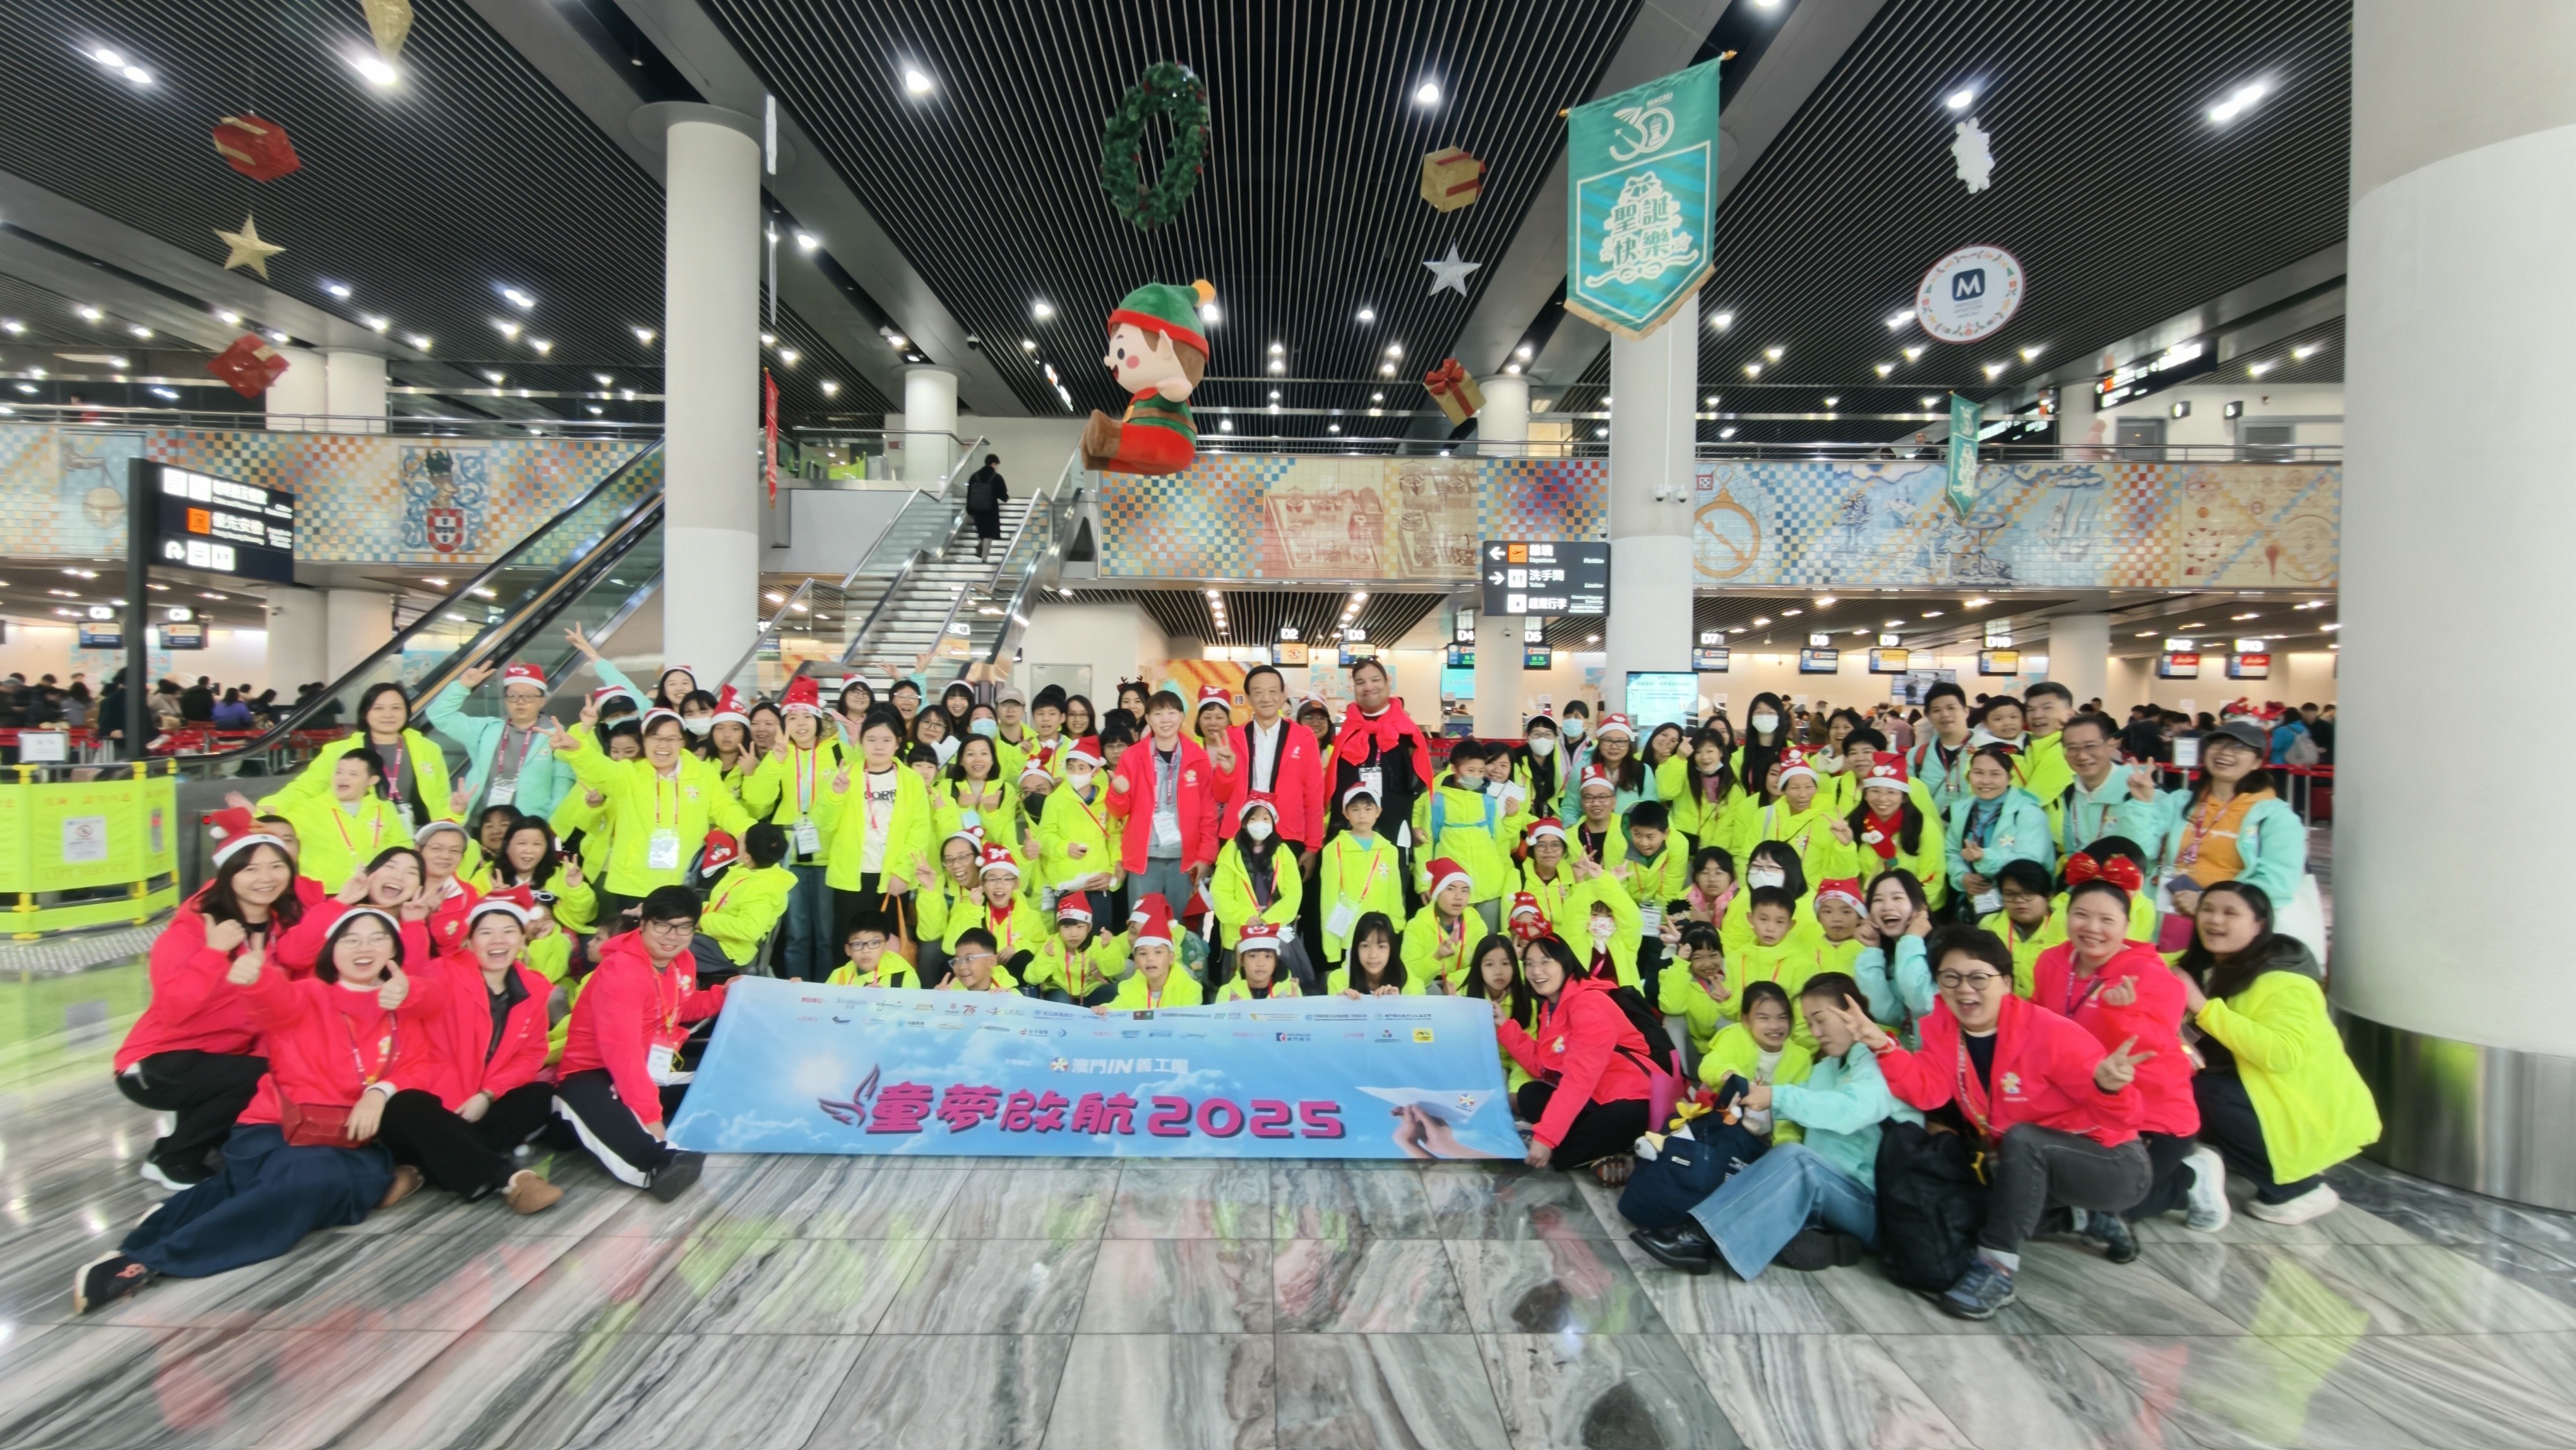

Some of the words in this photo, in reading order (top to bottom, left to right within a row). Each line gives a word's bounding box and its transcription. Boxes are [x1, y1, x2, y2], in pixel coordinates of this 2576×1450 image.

[1614, 195, 1669, 234] 聖誕
[1613, 227, 1670, 266] 快樂
[1955, 273, 1981, 298] M
[1280, 628, 1299, 639] D2
[1349, 629, 1366, 640] D3
[1457, 630, 1475, 641] D4
[1524, 630, 1542, 642] D5
[1701, 633, 1719, 644] D7
